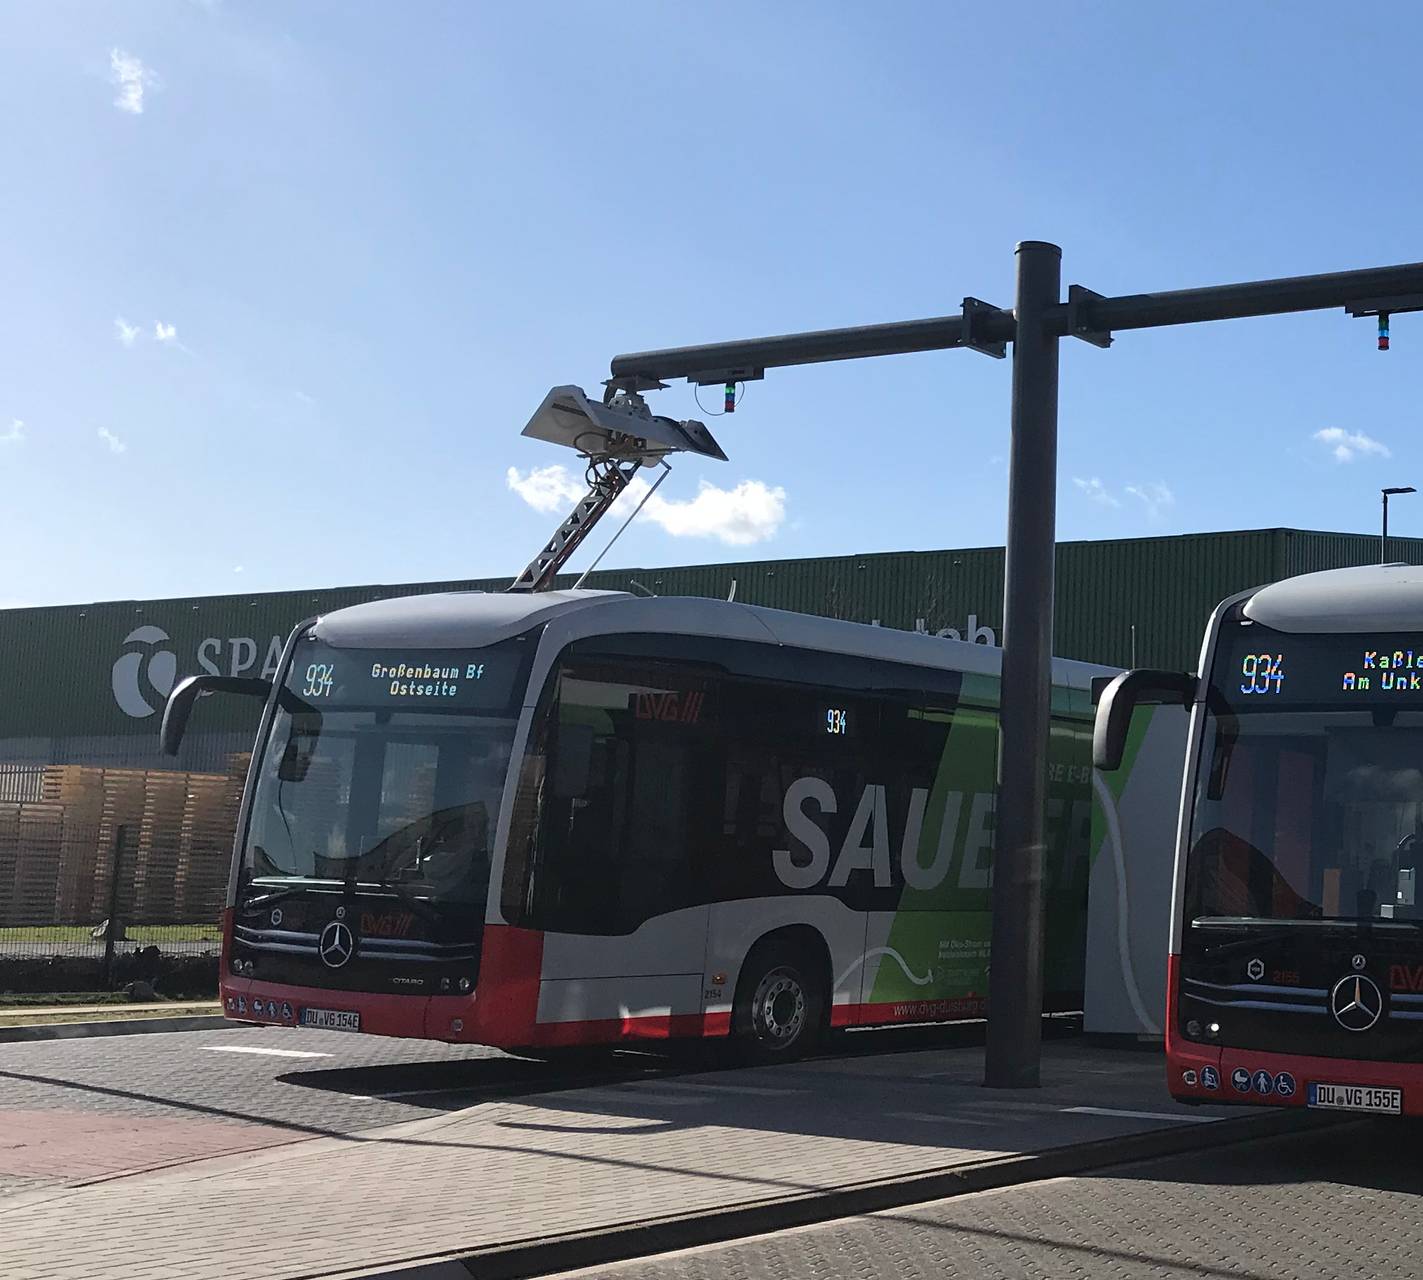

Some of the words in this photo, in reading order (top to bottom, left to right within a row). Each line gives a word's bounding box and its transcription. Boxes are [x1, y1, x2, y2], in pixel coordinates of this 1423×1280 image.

[303, 664, 334, 697] 934
[371, 663, 459, 679] Großenbaum
[465, 664, 485, 679] Bf
[1241, 654, 1284, 694] 934
[1343, 671, 1370, 690] Am
[390, 681, 457, 696] Ostseite
[826, 709, 846, 734] 934
[307, 1010, 318, 1024] DU
[324, 1012, 335, 1026] VG
[337, 1014, 359, 1028] 154E
[1318, 1086, 1335, 1104] DU
[1346, 1089, 1362, 1106] VG
[1366, 1089, 1400, 1109] 155E
